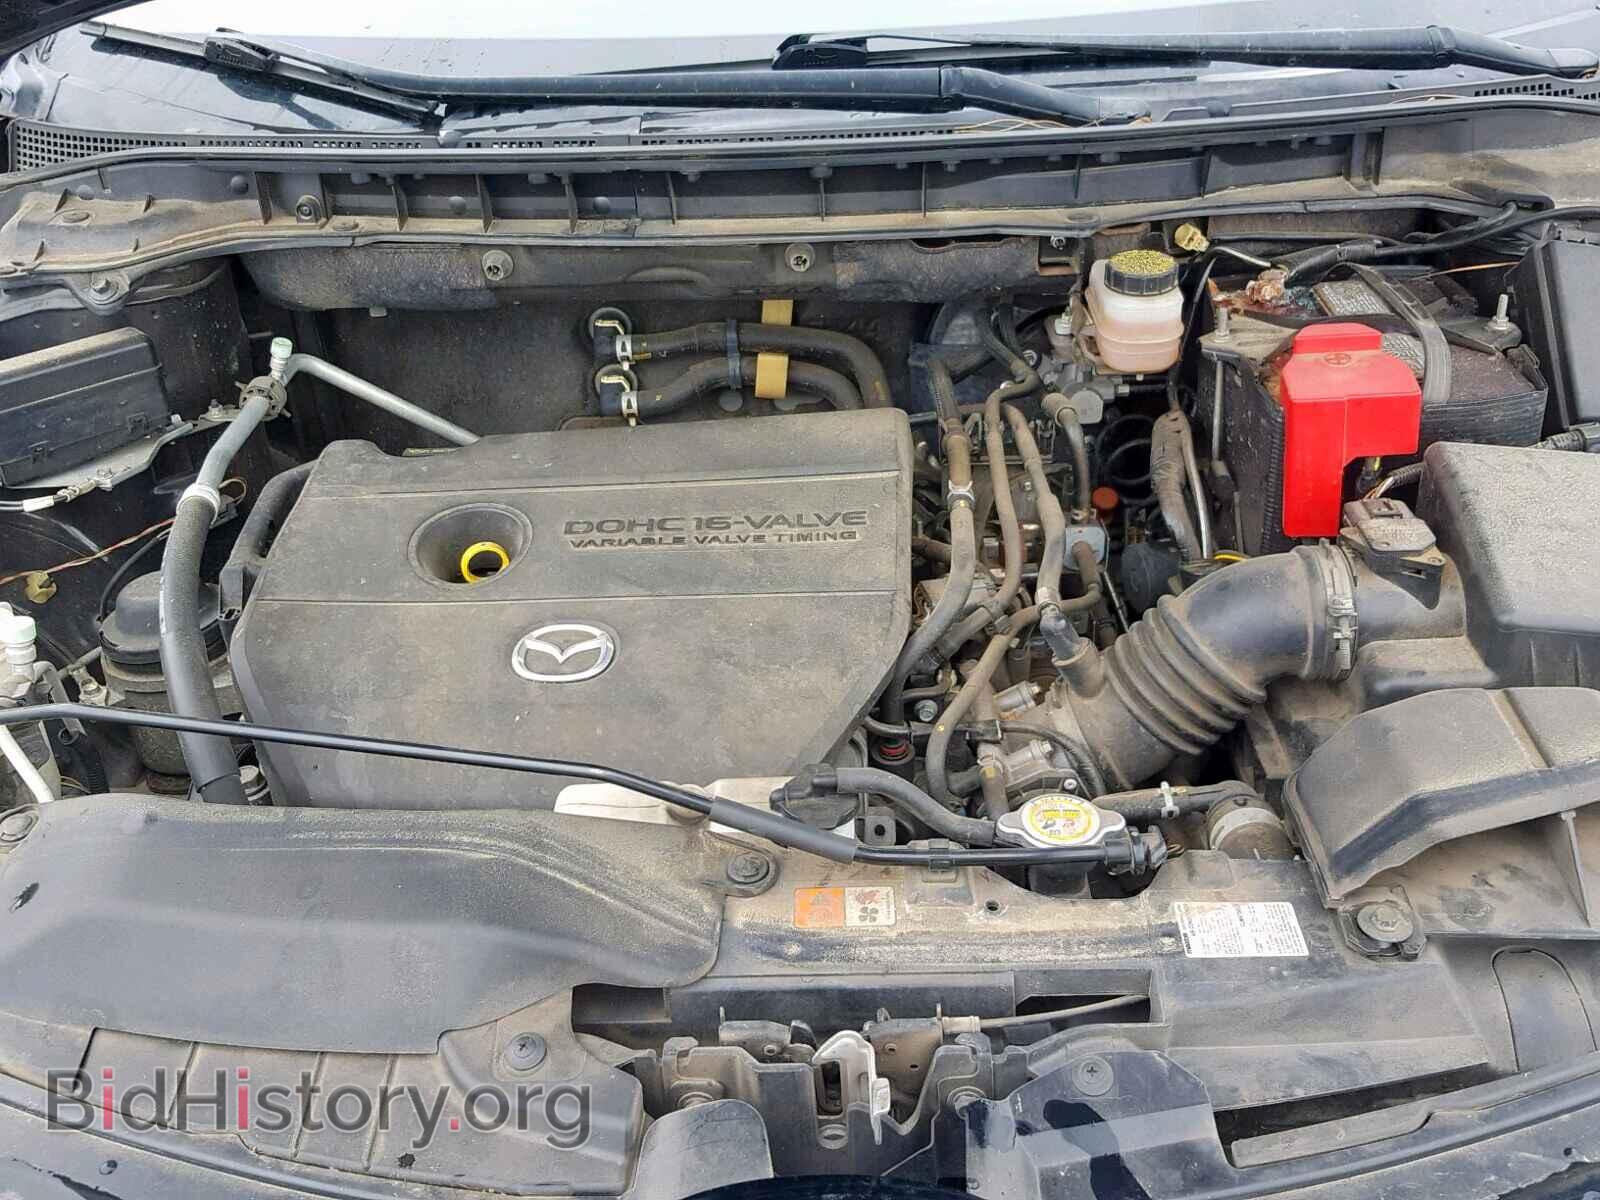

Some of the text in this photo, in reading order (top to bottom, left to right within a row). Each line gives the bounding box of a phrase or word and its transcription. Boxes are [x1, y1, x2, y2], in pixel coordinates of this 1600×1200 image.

[563, 510, 868, 535] DOHC 16-VALVE
[570, 530, 858, 548] VARIABLE VALVE TIMING
